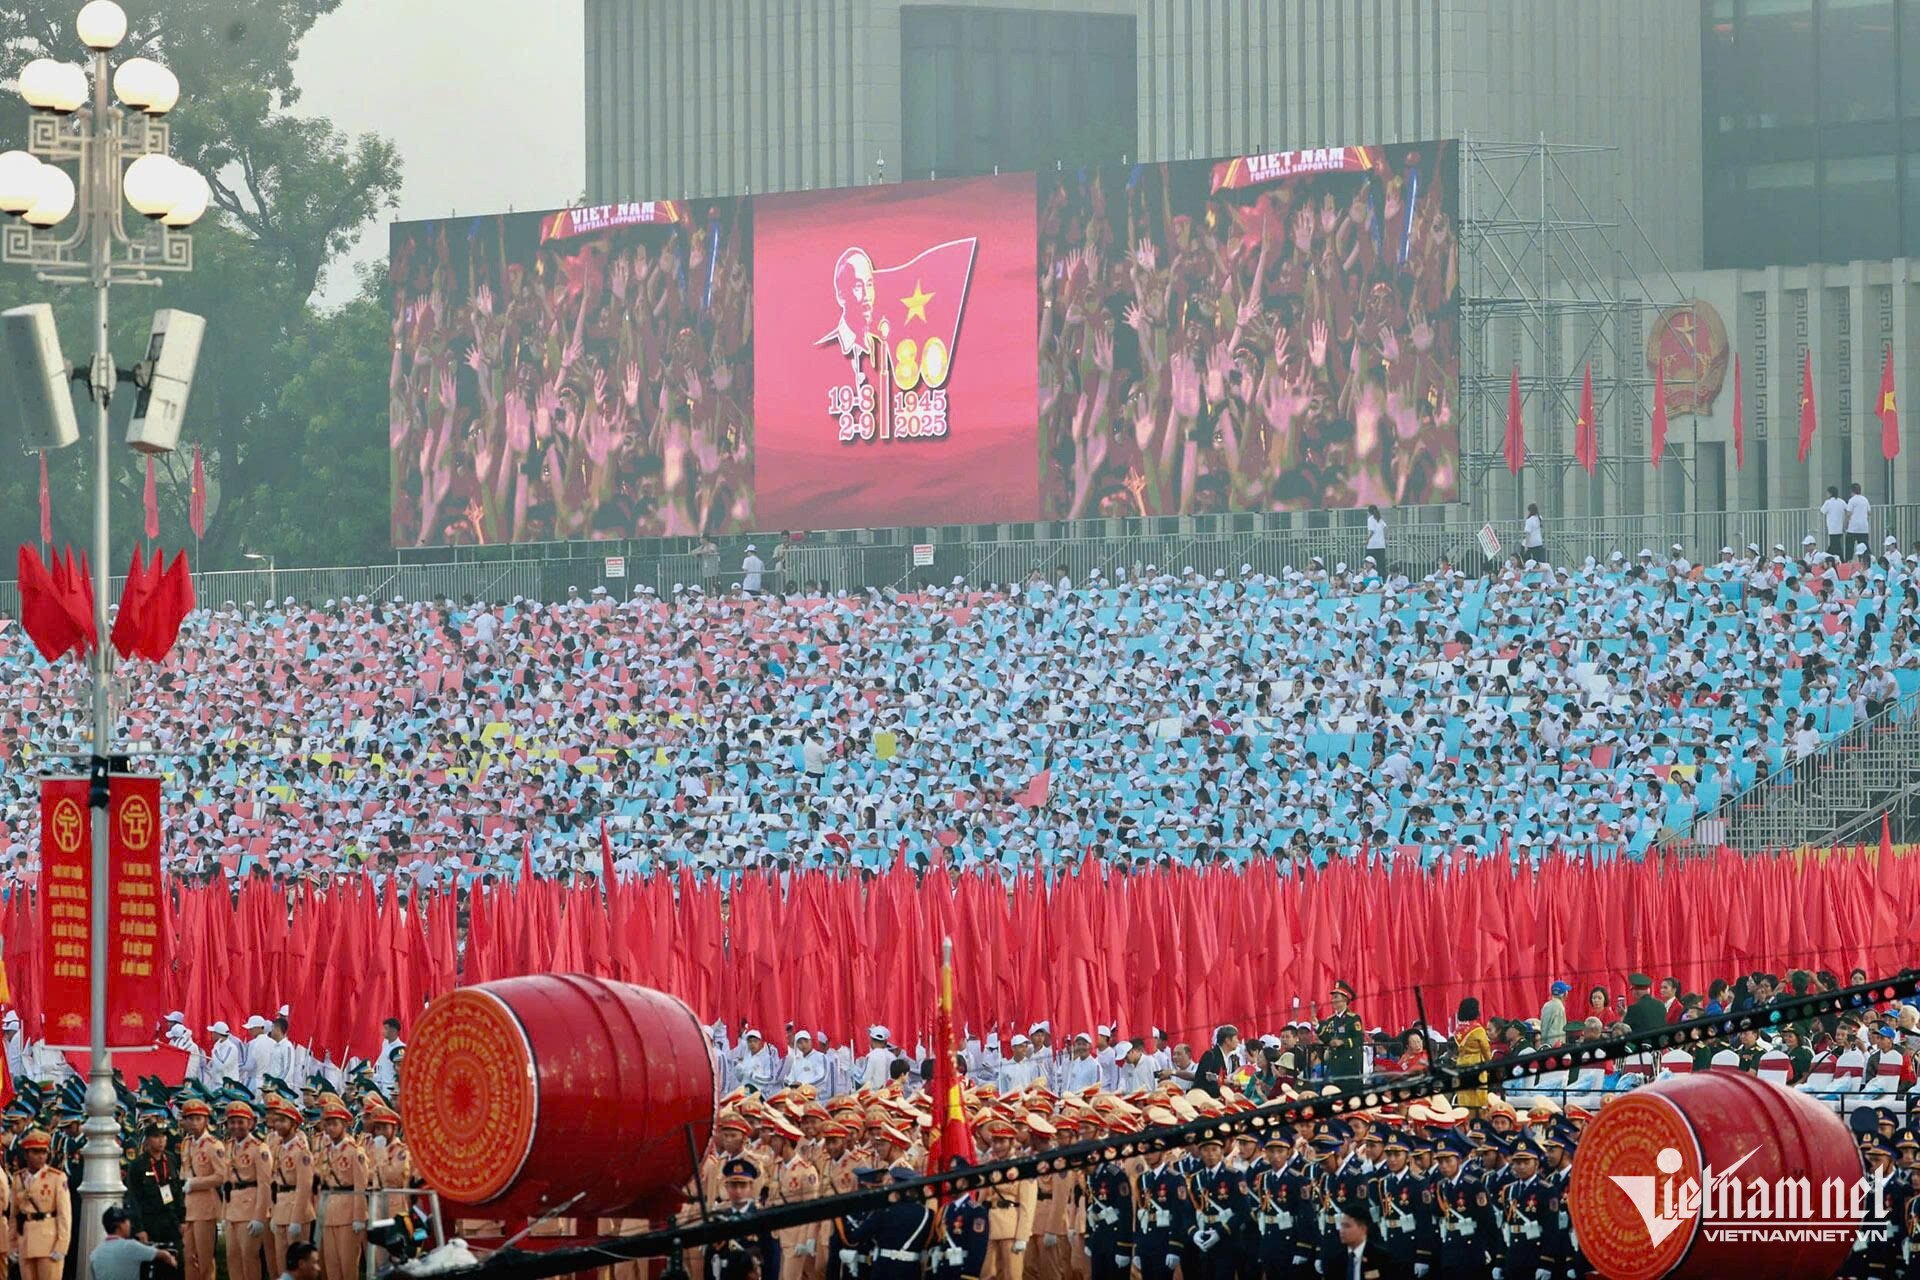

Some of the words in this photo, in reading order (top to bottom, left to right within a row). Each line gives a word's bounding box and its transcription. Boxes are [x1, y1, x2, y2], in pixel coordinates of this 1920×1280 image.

[1247, 151, 1294, 172] VIET
[1301, 147, 1344, 163] NAM
[1250, 167, 1291, 182] FOOTBALL
[1292, 159, 1344, 173] SUPPORTERS
[571, 204, 612, 225] VIET
[617, 201, 655, 217] NAM
[573, 219, 610, 233] FOOTBALL
[610, 213, 655, 225] SUPPORTERS
[895, 336, 949, 390] 80
[894, 390, 947, 415] 1945
[894, 413, 947, 437] 2025
